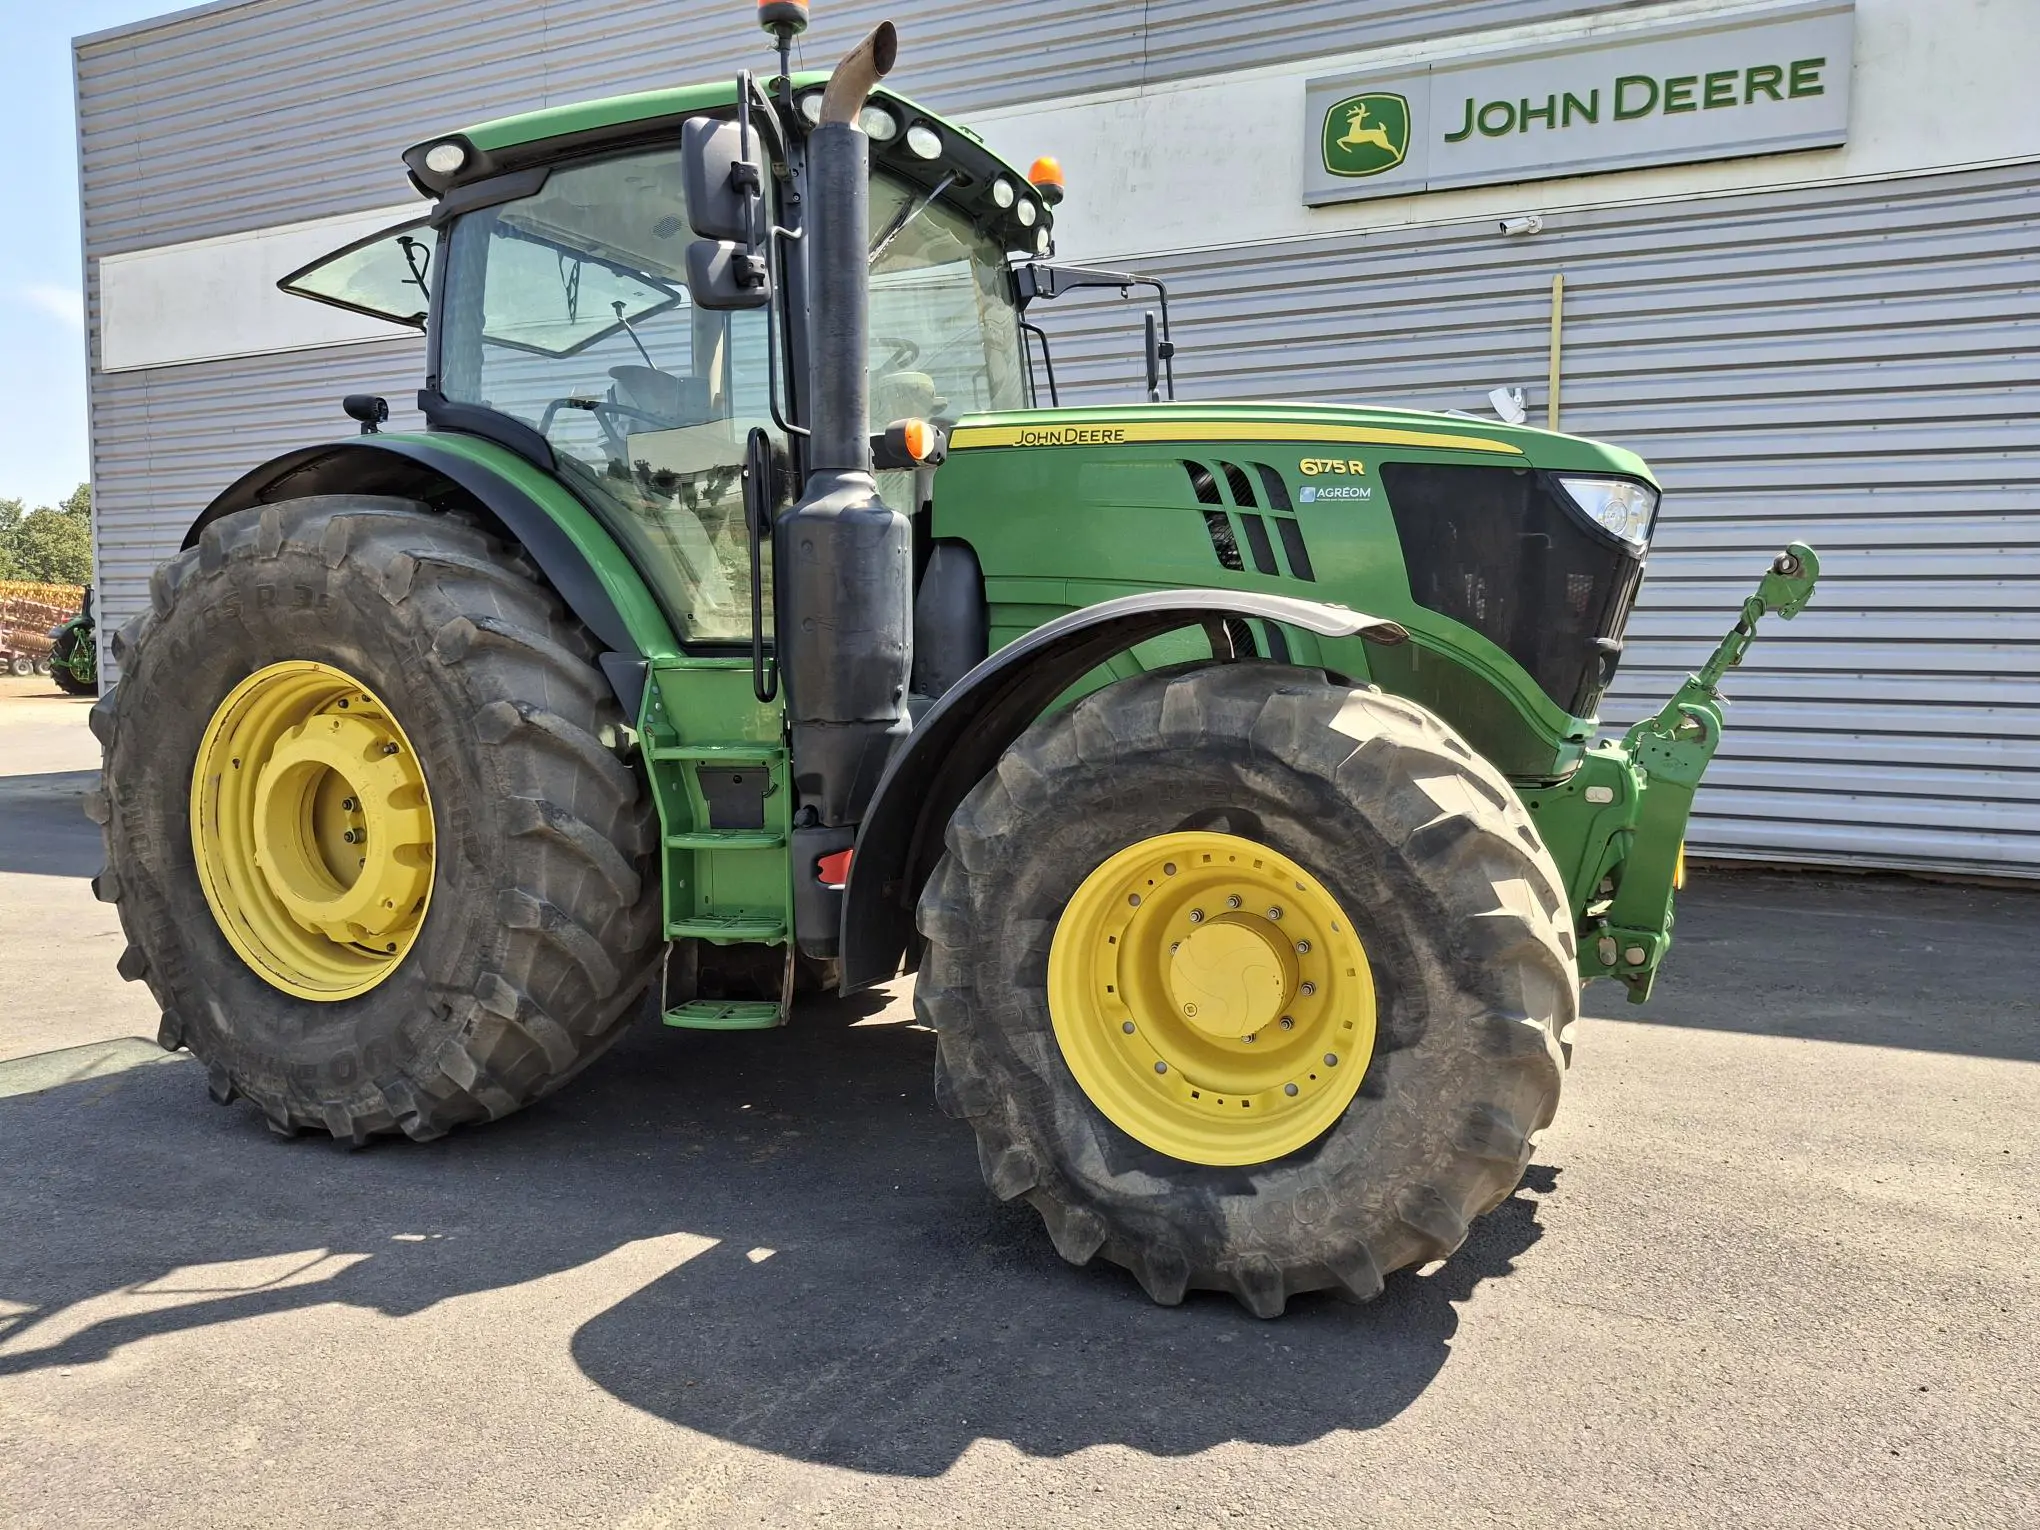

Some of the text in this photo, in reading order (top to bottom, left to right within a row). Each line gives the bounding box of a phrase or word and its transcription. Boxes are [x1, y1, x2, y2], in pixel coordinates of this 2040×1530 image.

[1444, 58, 1826, 143] JOHN DEERE
[1014, 428, 1125, 445] JOHN DEERE
